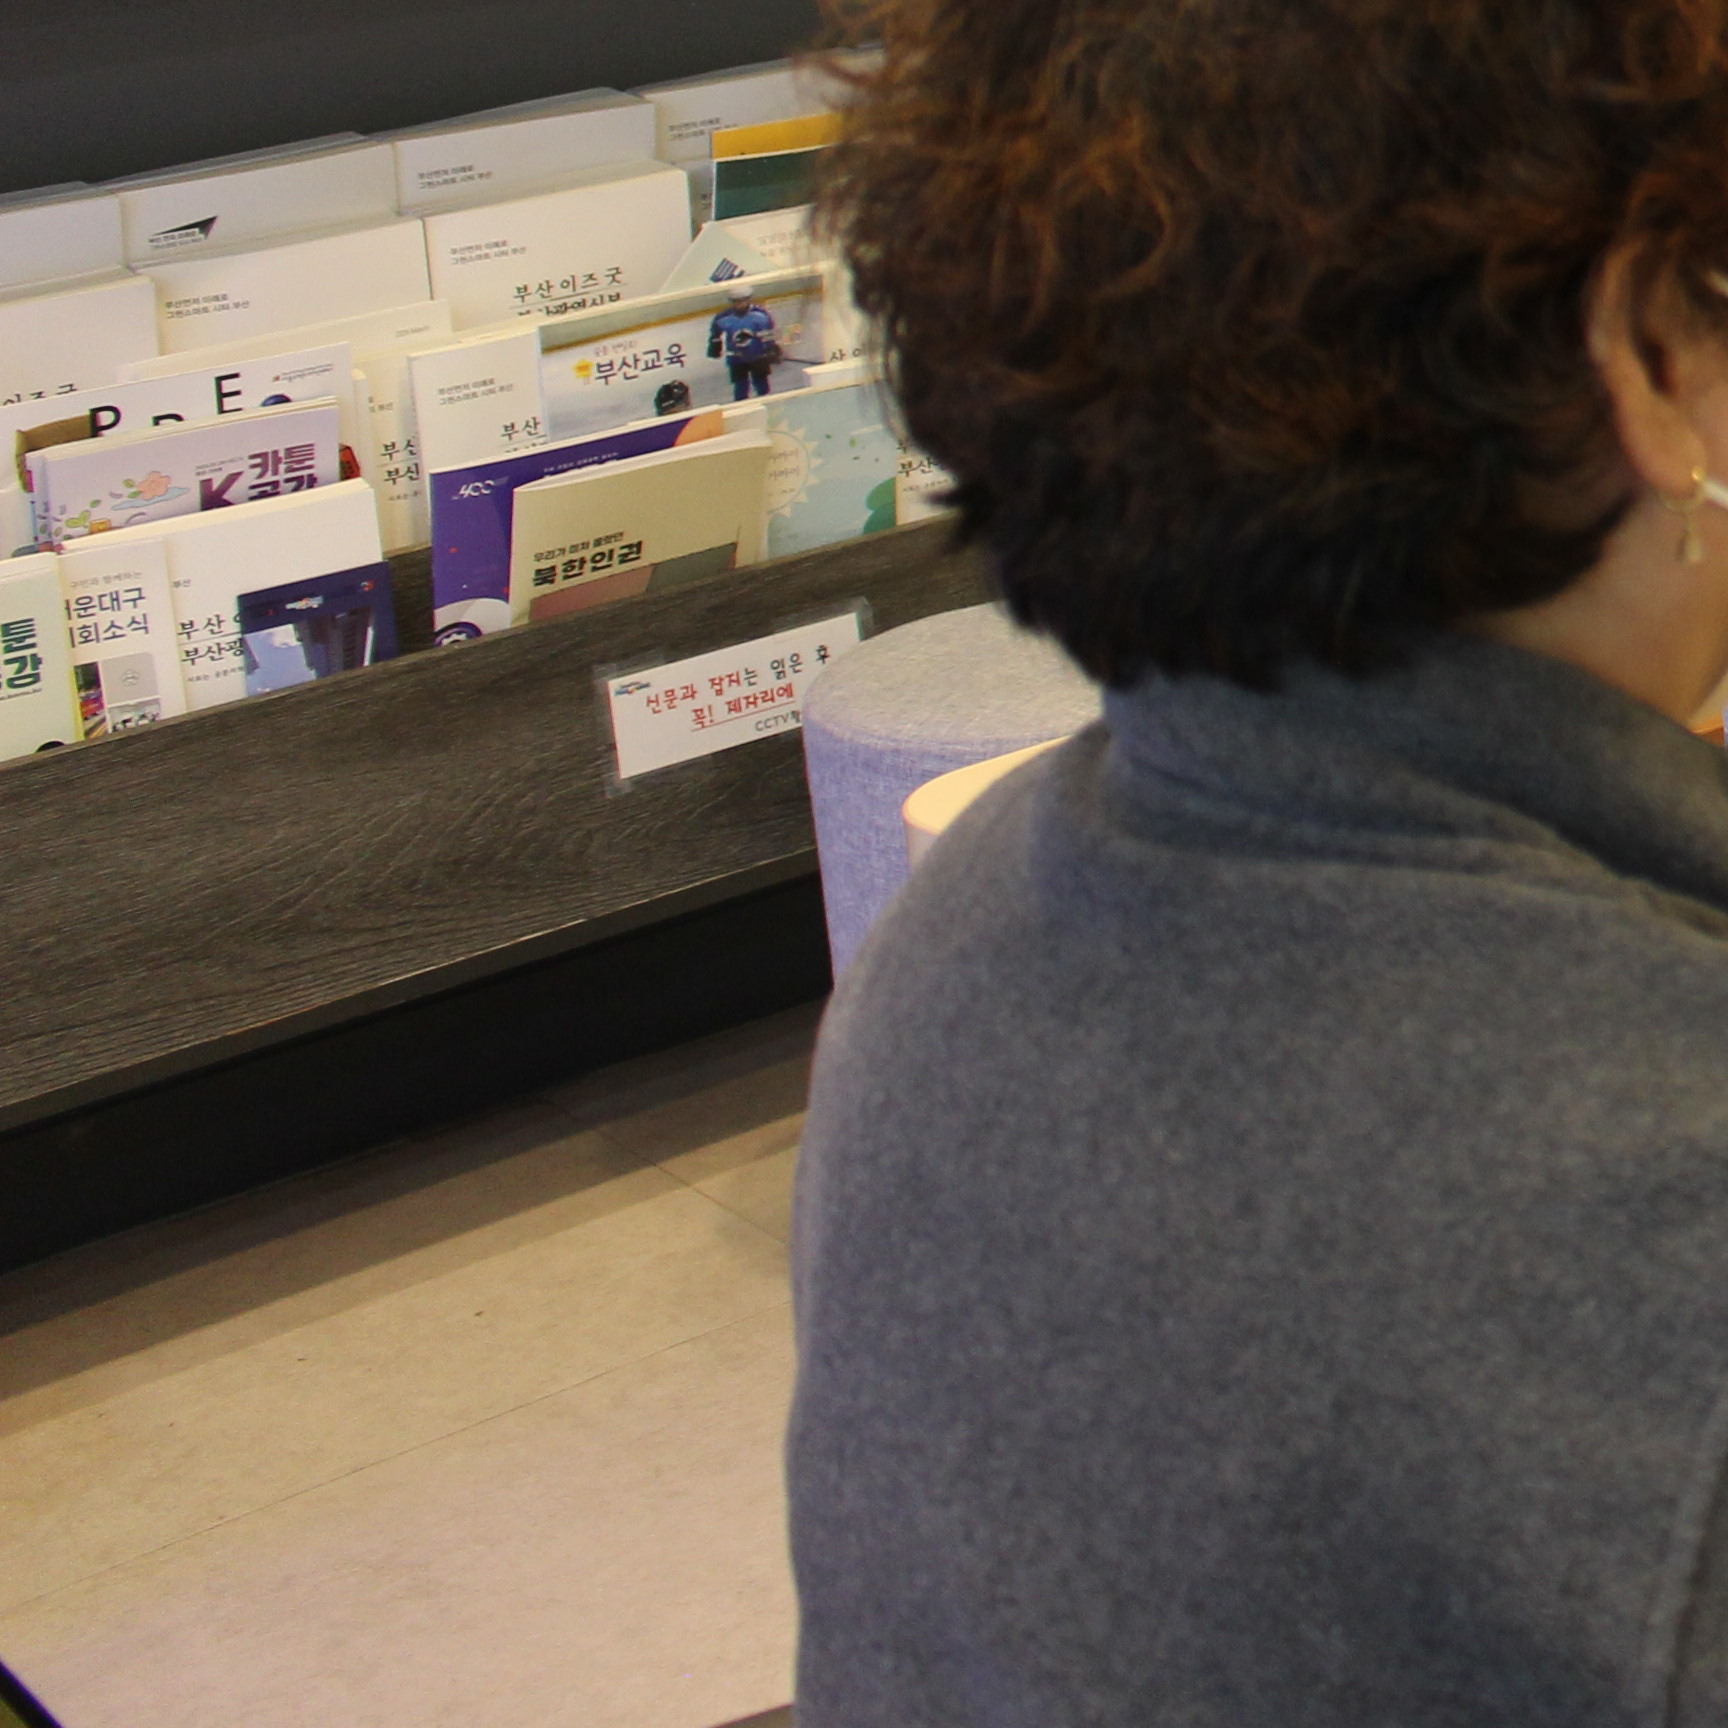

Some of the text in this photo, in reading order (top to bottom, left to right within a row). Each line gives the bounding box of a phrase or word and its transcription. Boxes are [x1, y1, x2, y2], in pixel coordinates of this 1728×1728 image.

[595, 343, 687, 385] 부산교육
[247, 443, 316, 480] 카툰
[199, 471, 244, 512] K
[532, 540, 643, 587] 북한인권
[0, 617, 37, 655] 툰
[68, 613, 150, 649] 회소식
[646, 683, 698, 715] 신문과
[708, 666, 758, 697] 잡지는
[770, 652, 803, 681] 읽은
[725, 682, 794, 716] 제자리에
